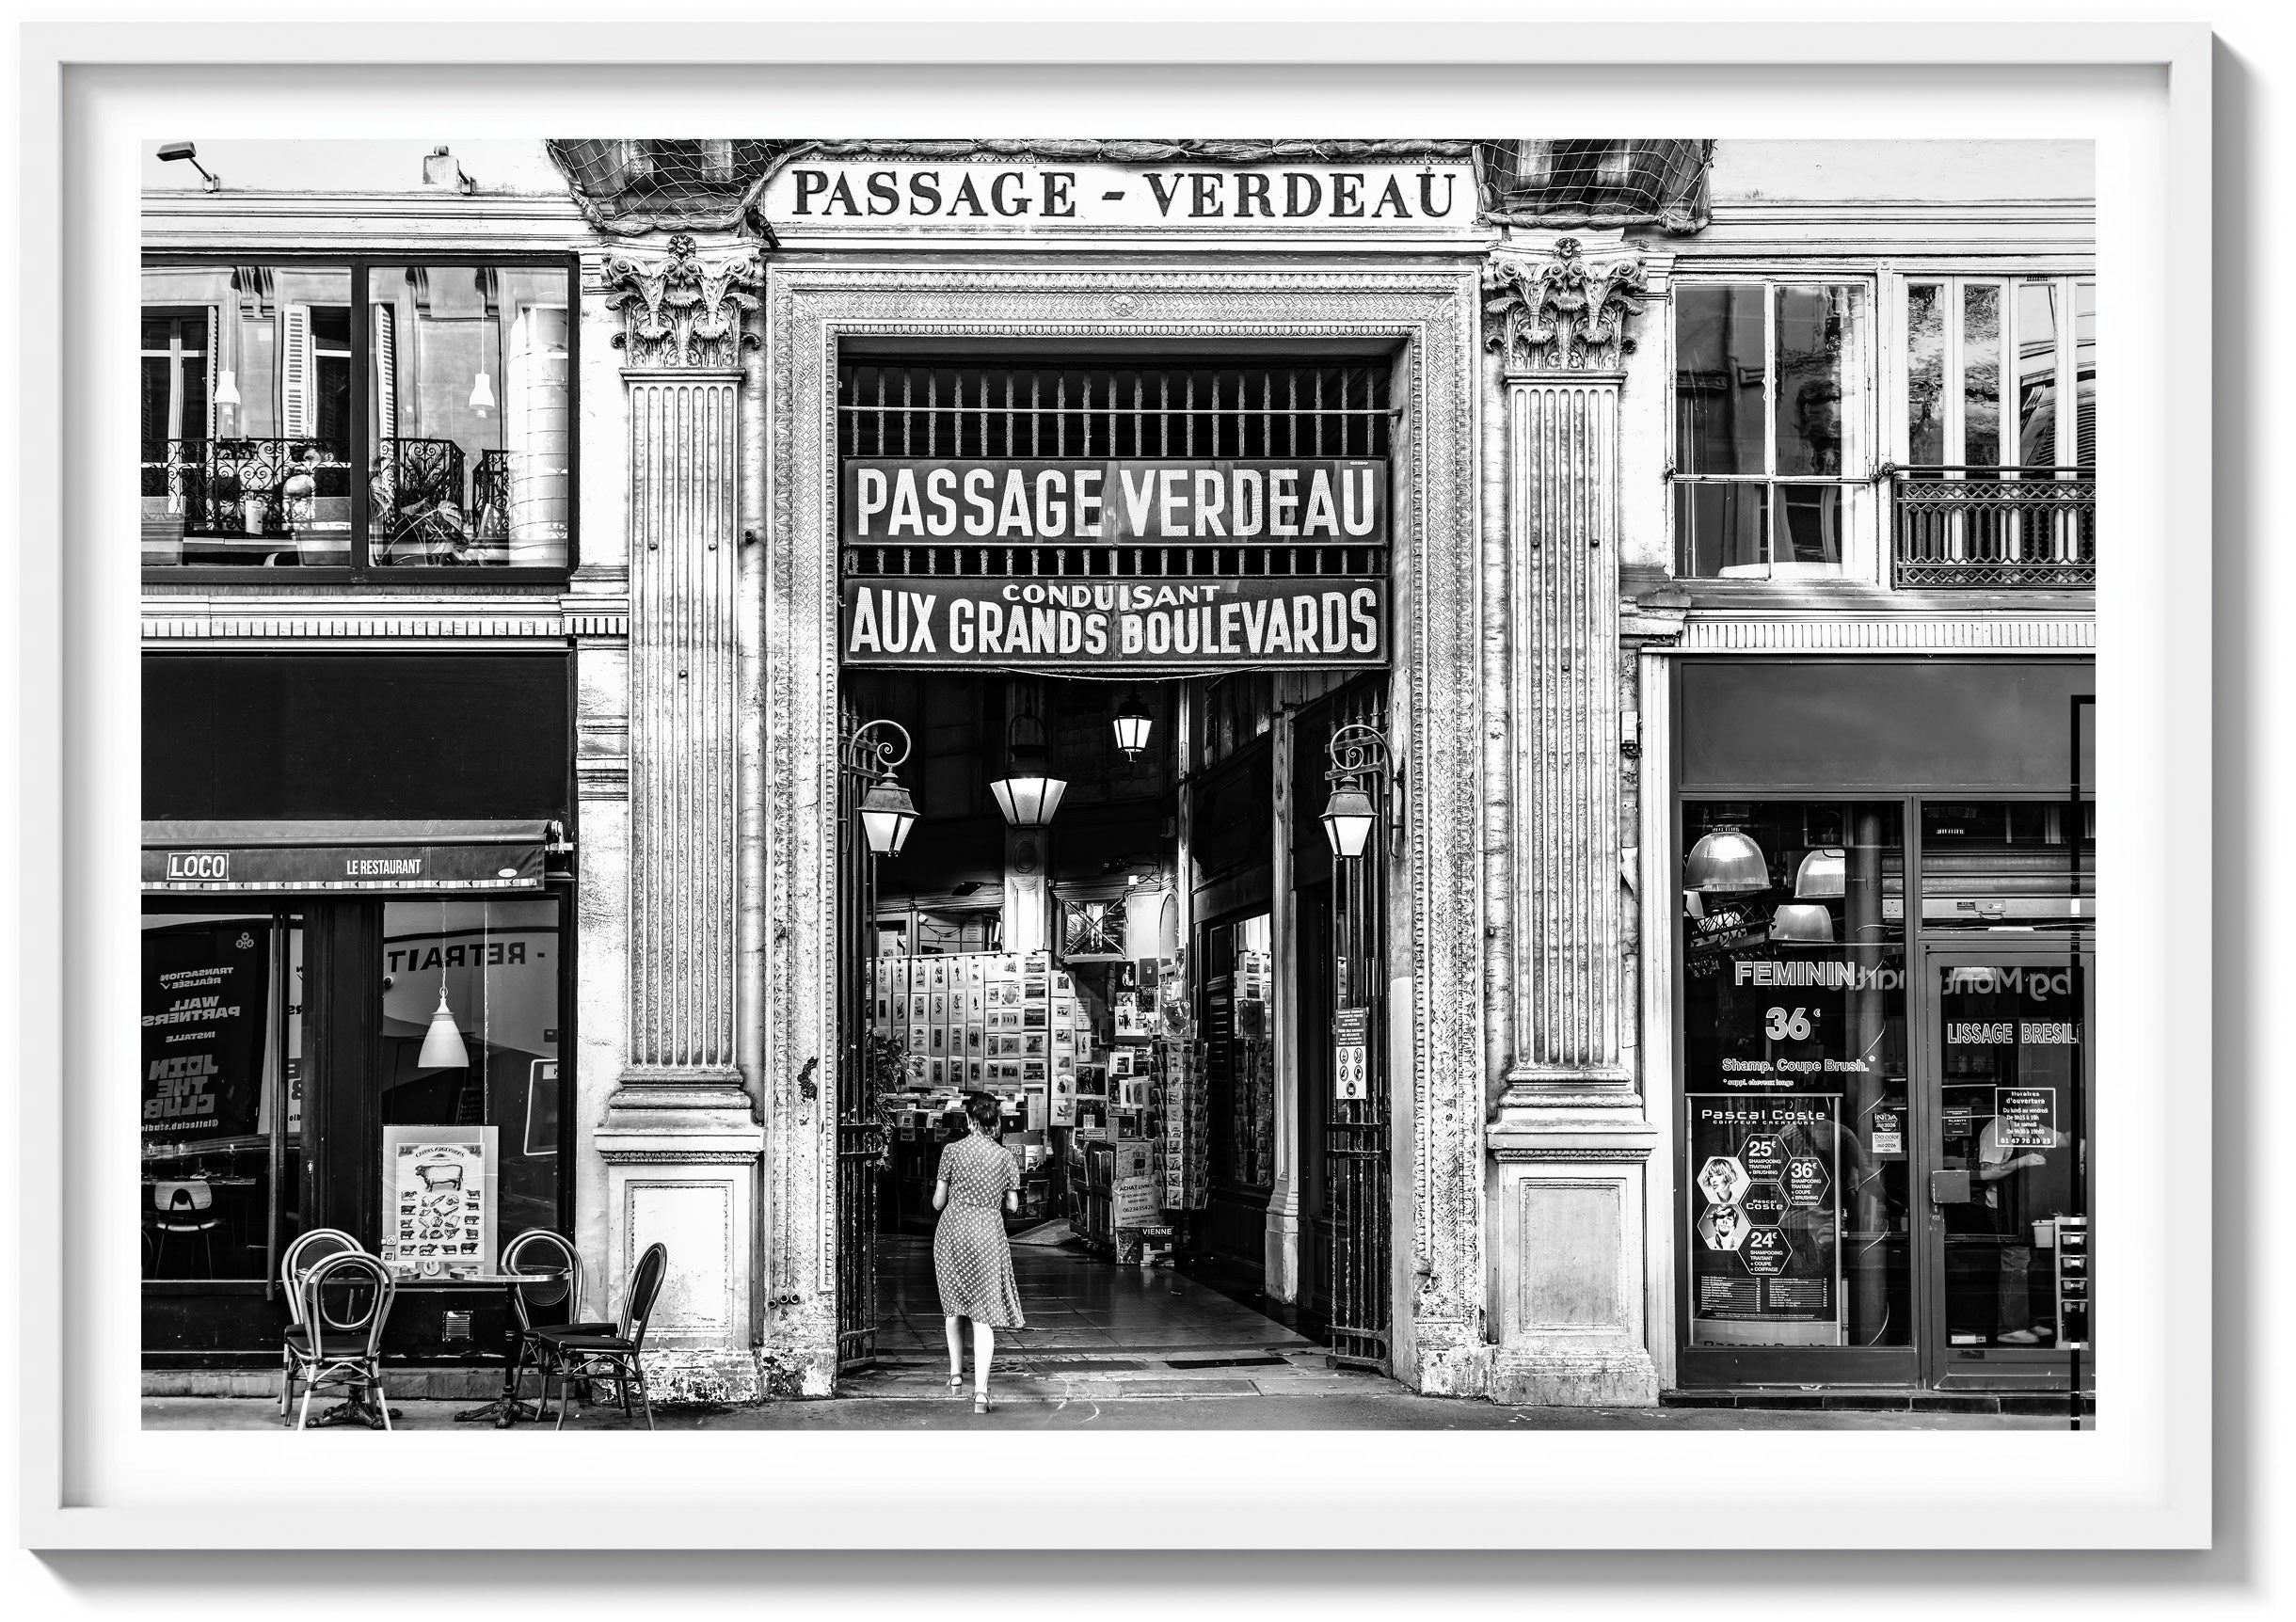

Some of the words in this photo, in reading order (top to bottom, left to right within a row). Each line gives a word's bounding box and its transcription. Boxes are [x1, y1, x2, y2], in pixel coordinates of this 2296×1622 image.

[790, 169, 1077, 217] PASSAGE
[1143, 171, 1457, 219] VERDEAU
[857, 468, 1103, 537] PASSAGE
[1119, 468, 1376, 537] VERDEAU
[1002, 583, 1221, 611] CONDUISANT
[850, 585, 938, 654] AUX
[949, 599, 1108, 657] GRANDS
[1121, 588, 1379, 655] BOULEVARDS
[170, 855, 225, 877] LOCO
[347, 860, 359, 874] LE
[360, 859, 421, 874] RESTAURANT
[1735, 962, 1855, 986] FEMININ
[1947, 1023, 2013, 1044] LISSAGE
[1722, 1058, 1774, 1073] Shamp.
[1777, 1058, 1821, 1073] Coupe
[1702, 1110, 1765, 1120] Pascal
[1773, 1110, 1826, 1120] Coste
[1748, 1140, 1777, 1156] 25€
[1791, 1163, 1817, 1178] 36€
[1750, 1232, 1778, 1248] 24€
